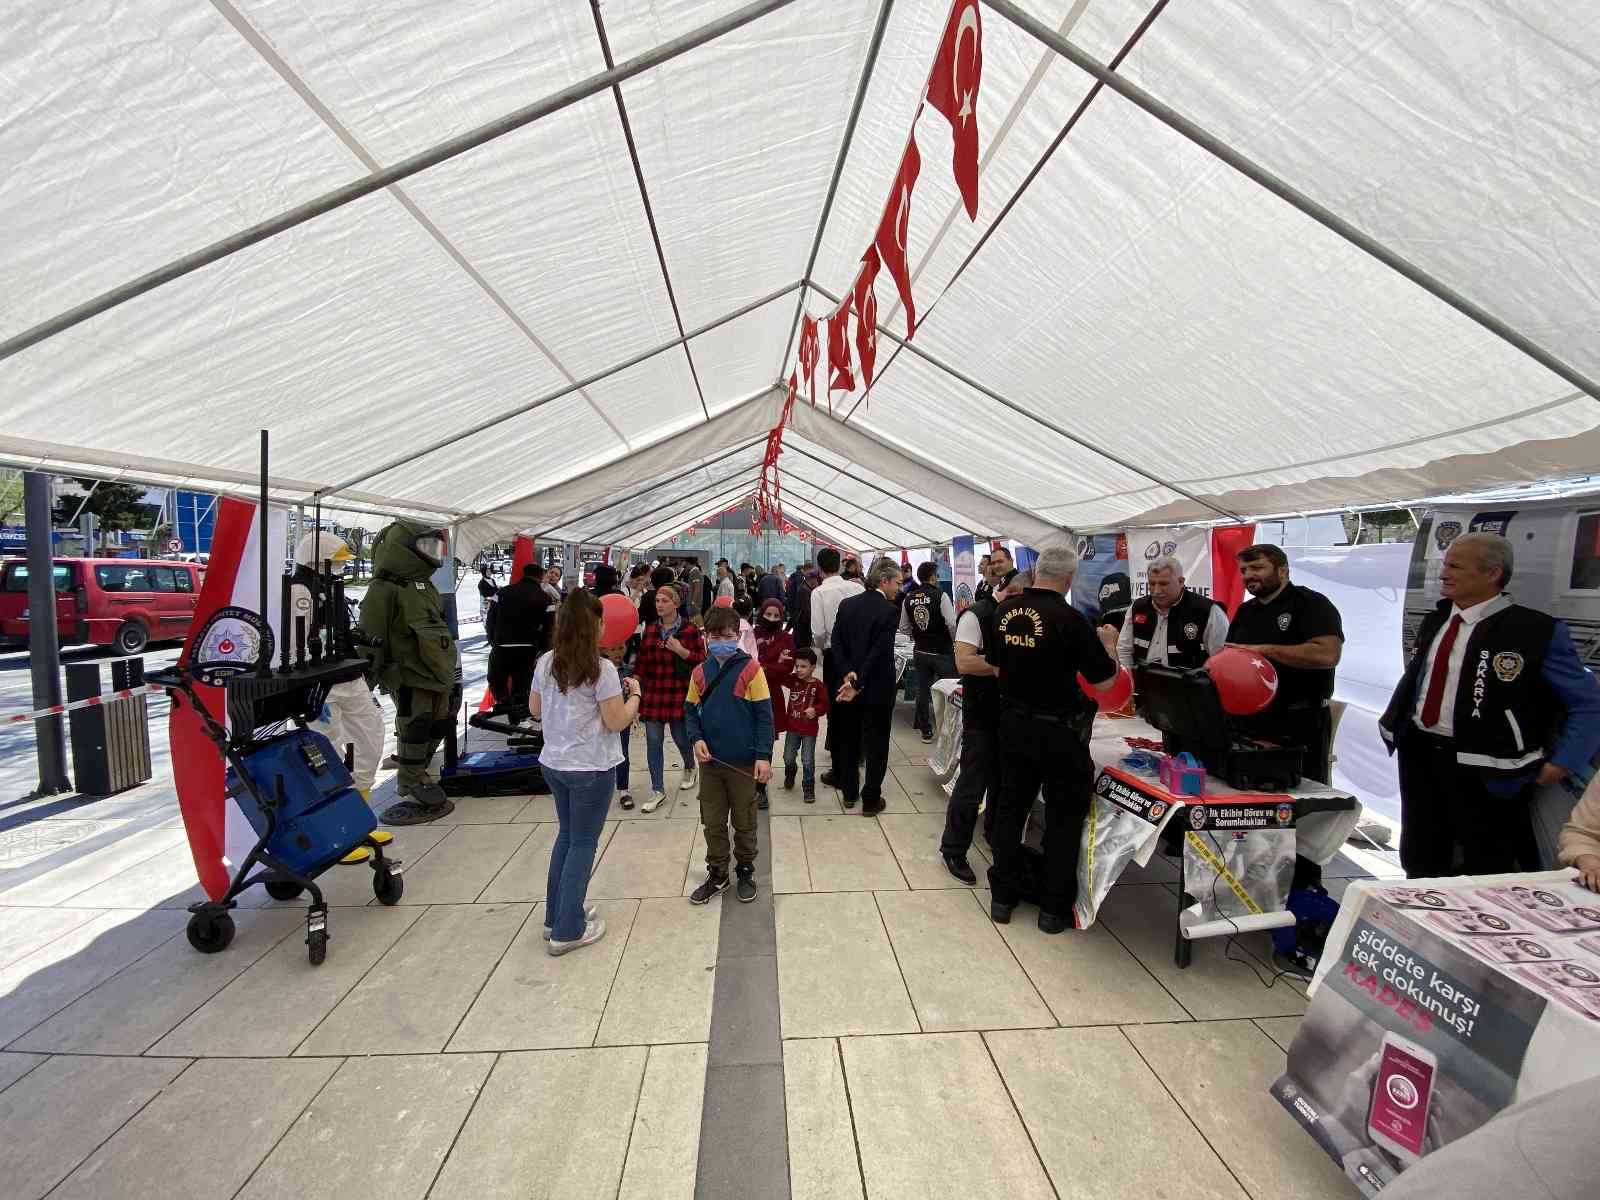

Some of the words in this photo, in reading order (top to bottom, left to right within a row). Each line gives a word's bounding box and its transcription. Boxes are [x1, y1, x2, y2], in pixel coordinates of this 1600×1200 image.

[910, 595, 931, 606] POLİS
[999, 607, 1024, 631] BOMBA
[1024, 607, 1043, 637] UZMANI
[1004, 634, 1036, 648] POLİS
[1472, 650, 1489, 718] SAKARYA
[1209, 807, 1219, 818] İlk
[1220, 808, 1243, 818] Ekibin
[1243, 807, 1265, 818] Görev
[1265, 808, 1274, 817] ve
[1215, 817, 1267, 827] Sorumlulukları
[1358, 929, 1425, 980] şiddete
[1429, 971, 1481, 1017] karşı
[1352, 943, 1379, 974] tek
[1382, 967, 1475, 1037] dokunuş!
